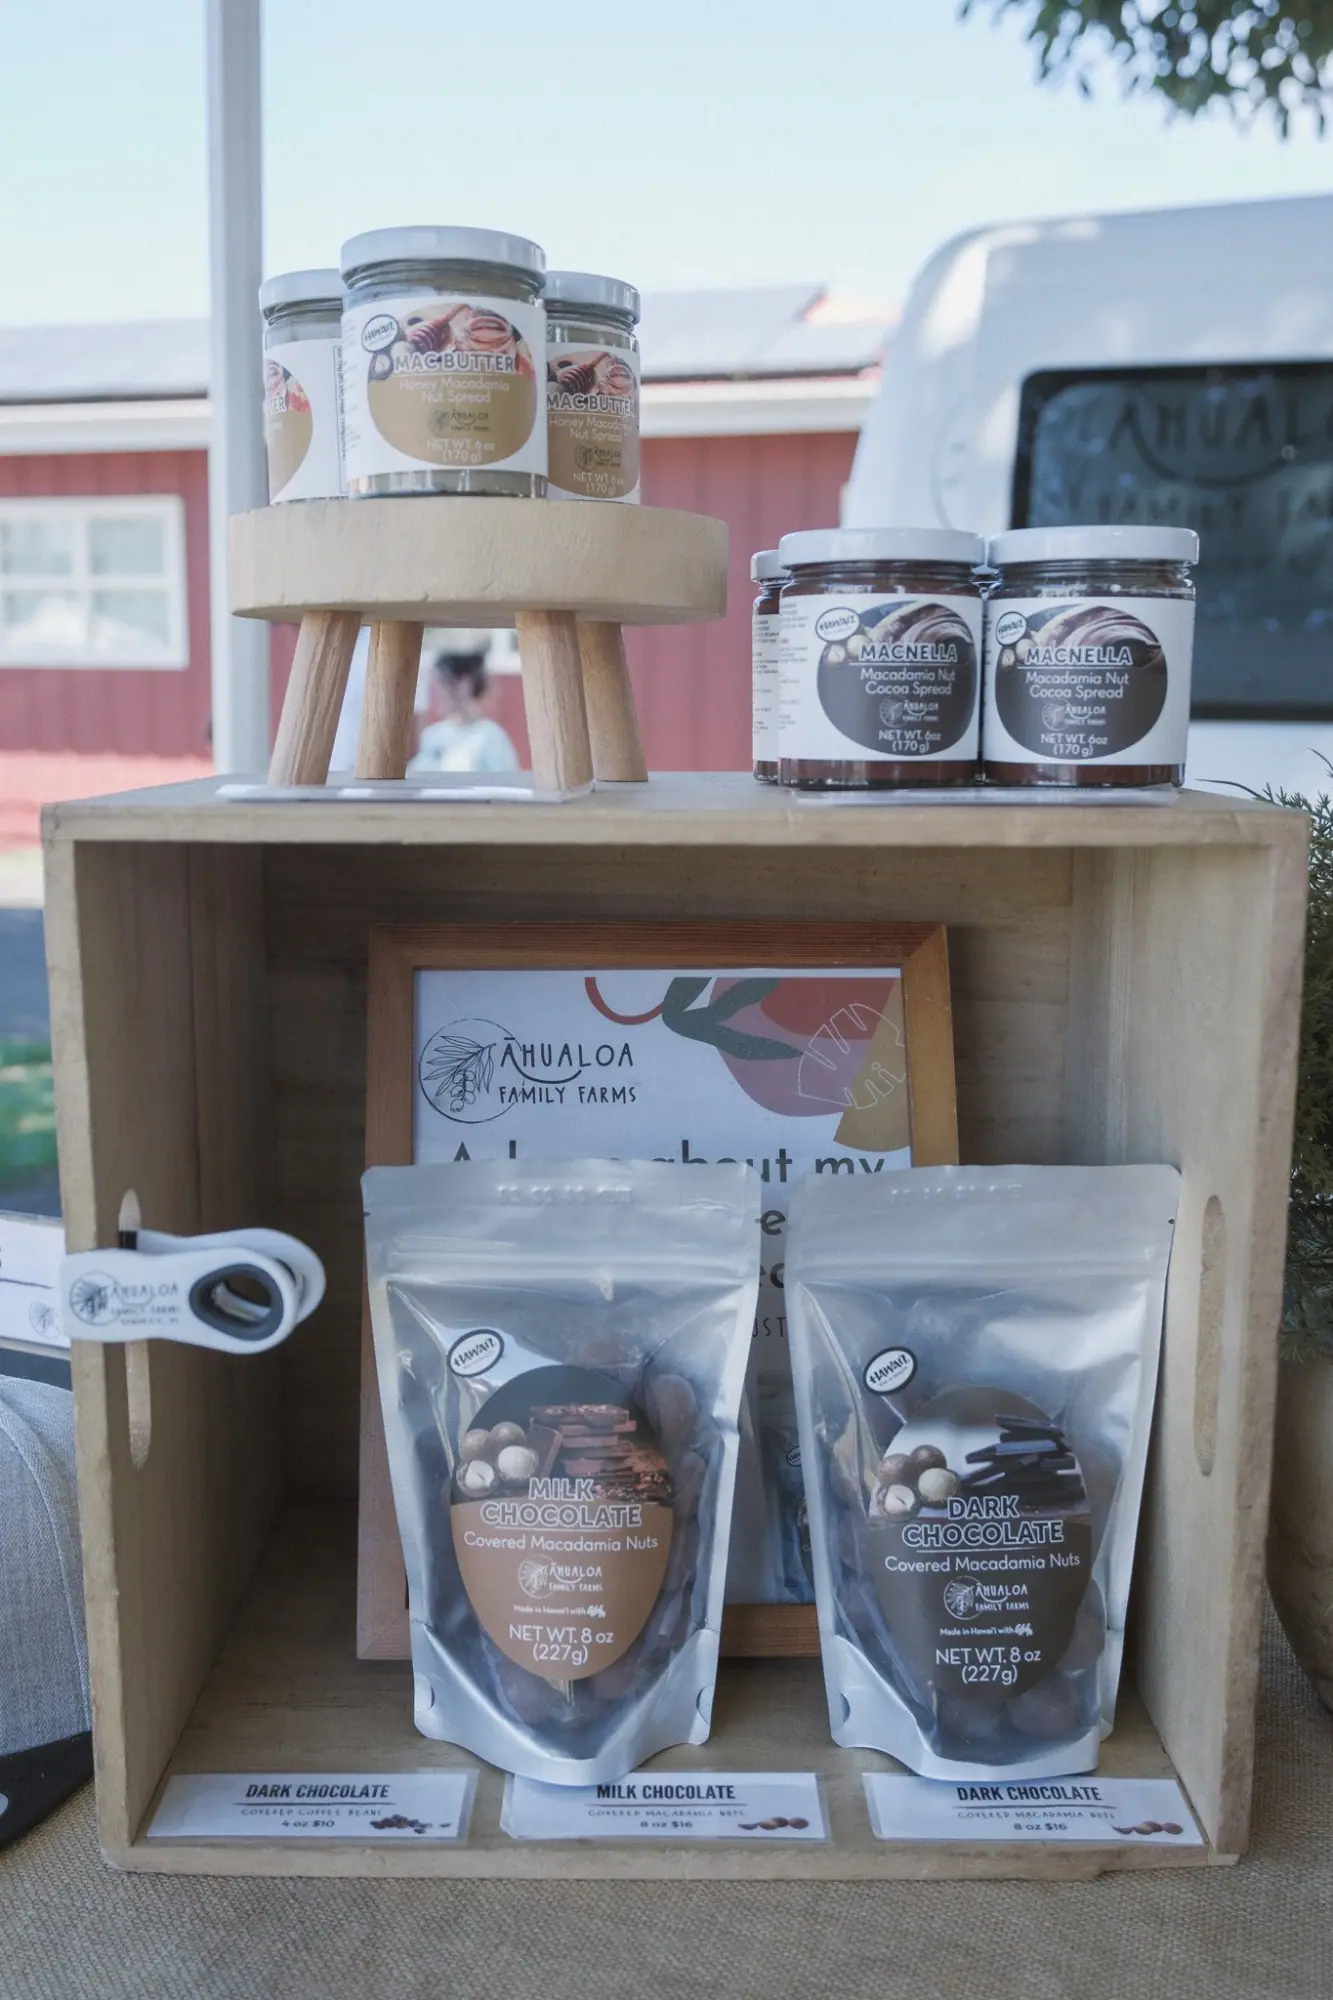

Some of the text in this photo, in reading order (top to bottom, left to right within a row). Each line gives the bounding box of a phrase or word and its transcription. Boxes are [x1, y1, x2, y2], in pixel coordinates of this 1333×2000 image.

[393, 351, 516, 373] MAC BUTTER
[441, 378, 510, 391] Macadamia
[422, 391, 492, 403] Nut Spread
[547, 393, 585, 410] MAC
[426, 439, 451, 450] NET
[859, 643, 958, 662] MACNELLA
[1024, 646, 1133, 665] MACNELLA
[860, 668, 956, 681] Macadamia Nut
[1025, 671, 1130, 685] Macadamia Nut
[864, 681, 952, 697] Cocoa Spread
[1029, 685, 1124, 701] Cocoa Spread
[879, 731, 902, 740] NET
[1041, 733, 1064, 744] NET
[499, 1086, 636, 1104] FAMILY FARMS
[528, 1477, 595, 1501] MILK
[480, 1502, 642, 1528] CHOCOLATE
[948, 1495, 1020, 1520] DARK
[464, 1531, 658, 1551] Covered Macadamia Nuts
[901, 1520, 1064, 1547] CHOCOLATE
[885, 1553, 1080, 1572] Covered Macadamia Nuts
[975, 1602, 1002, 1611] FAMILY
[509, 1623, 614, 1644] NET WT. 8 oz
[940, 1628, 961, 1636] Made
[997, 1626, 1014, 1634] with
[533, 1643, 588, 1666] (227g)
[935, 1646, 1041, 1664] NET WT. 8 oz
[961, 1664, 1018, 1686] (227g)
[245, 1784, 391, 1798] DARK CHOCOLATE
[596, 1785, 736, 1799] MILK CHOCOLATE
[956, 1786, 1102, 1801] DARK CHOCOLATE
[958, 1811, 1010, 1819] COVERED
[1015, 1811, 1084, 1819] MACADAMIA
[281, 1820, 290, 1828] 4
[312, 1820, 335, 1828] $10
[671, 1820, 693, 1829] $16
[1044, 1822, 1068, 1831] $16
